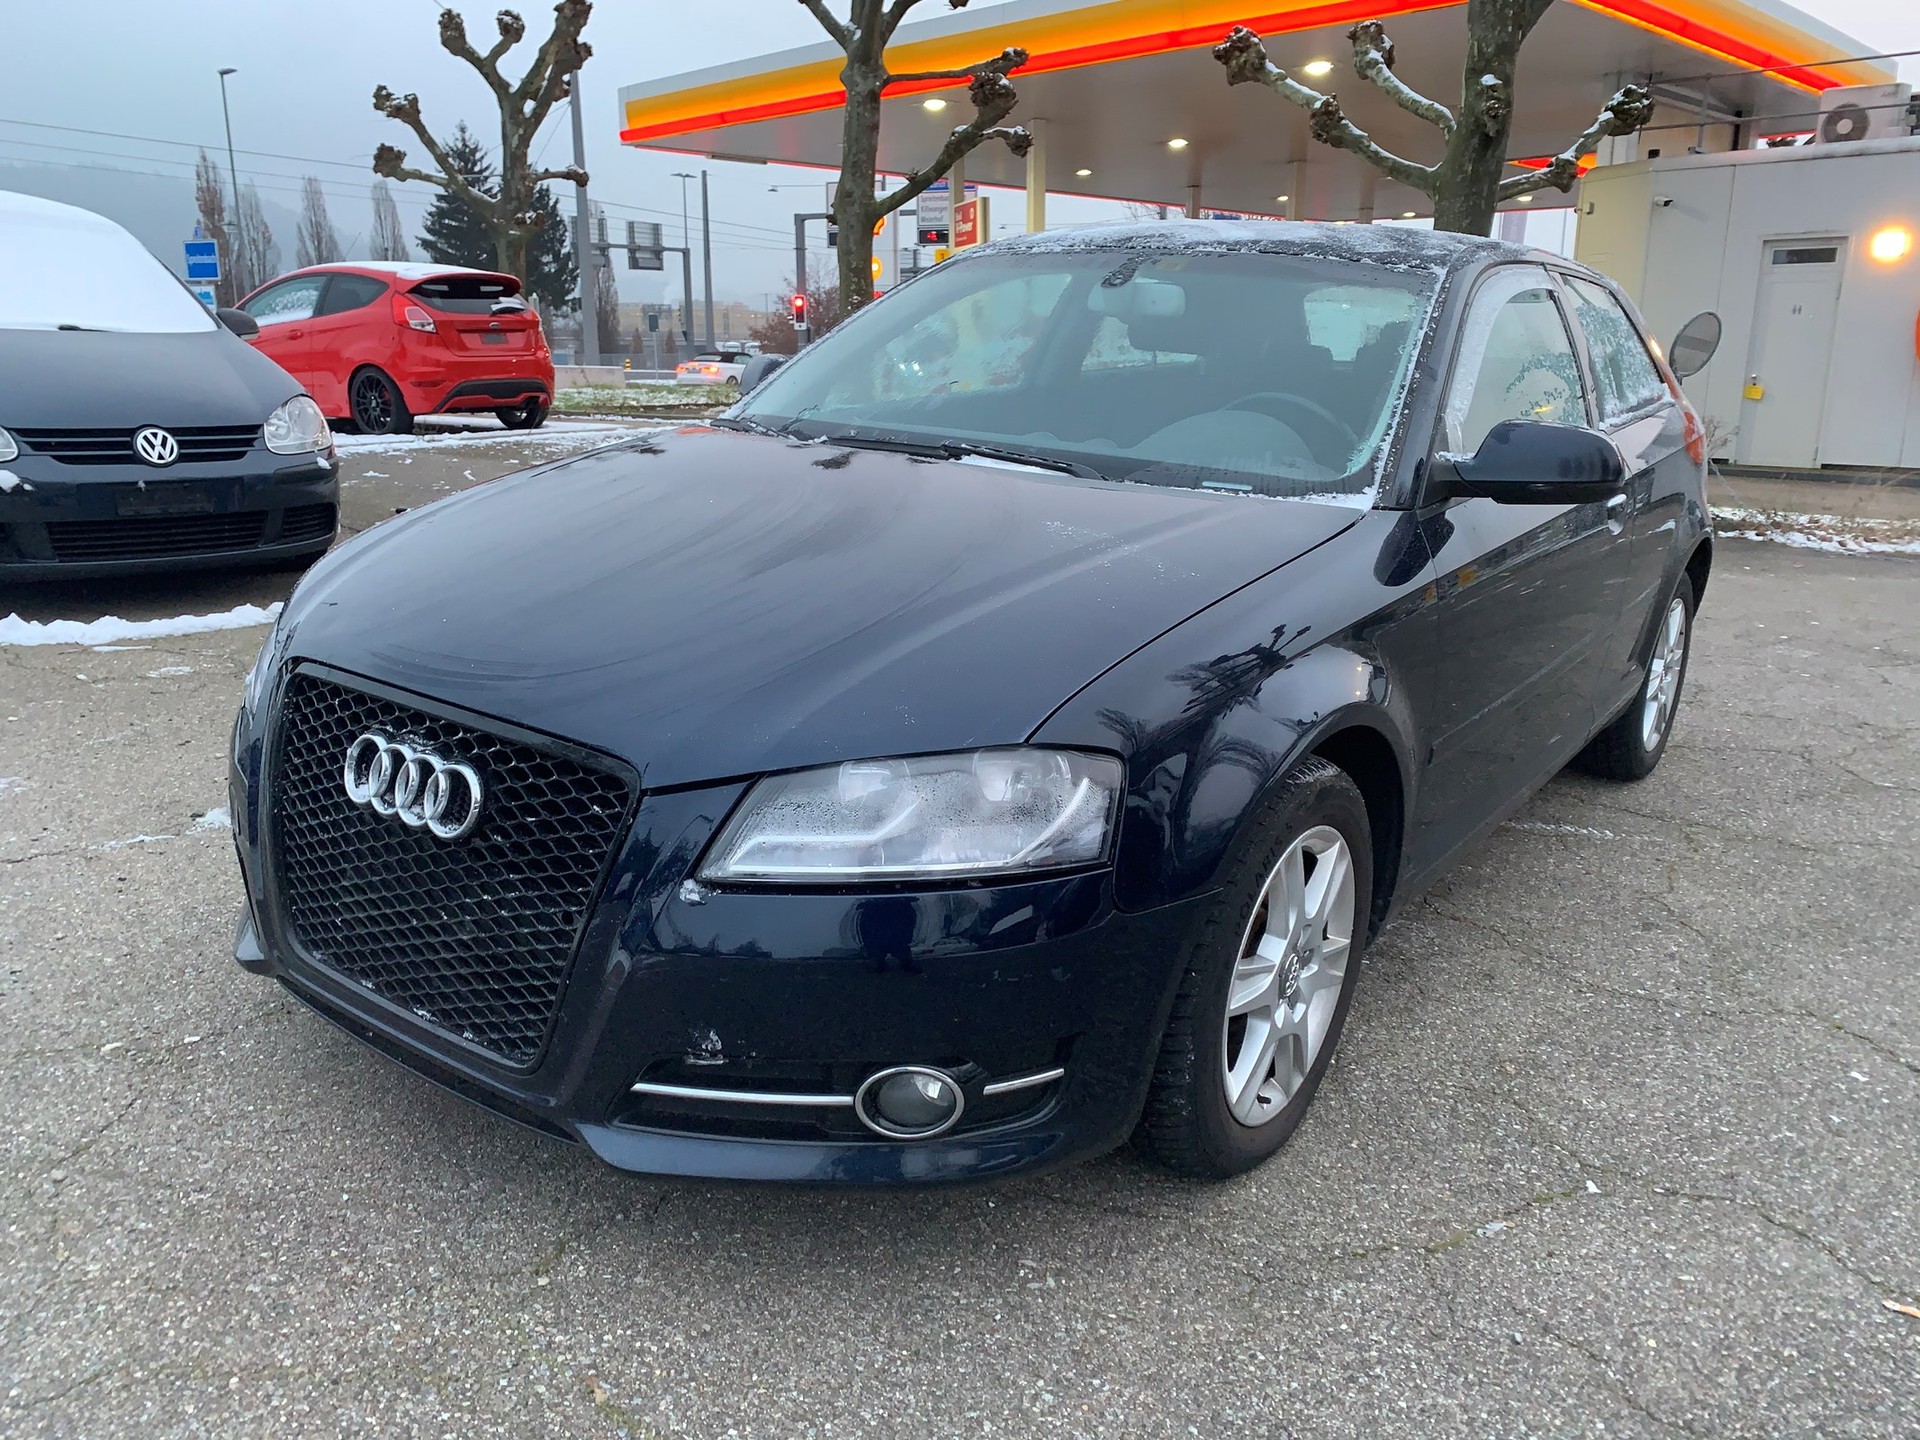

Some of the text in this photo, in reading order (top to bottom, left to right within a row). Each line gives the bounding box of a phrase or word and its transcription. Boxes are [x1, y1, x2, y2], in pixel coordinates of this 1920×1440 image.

[921, 195, 949, 203] Spreitenba
[921, 206, 949, 214] Killwange
[137, 429, 177, 463] VW
